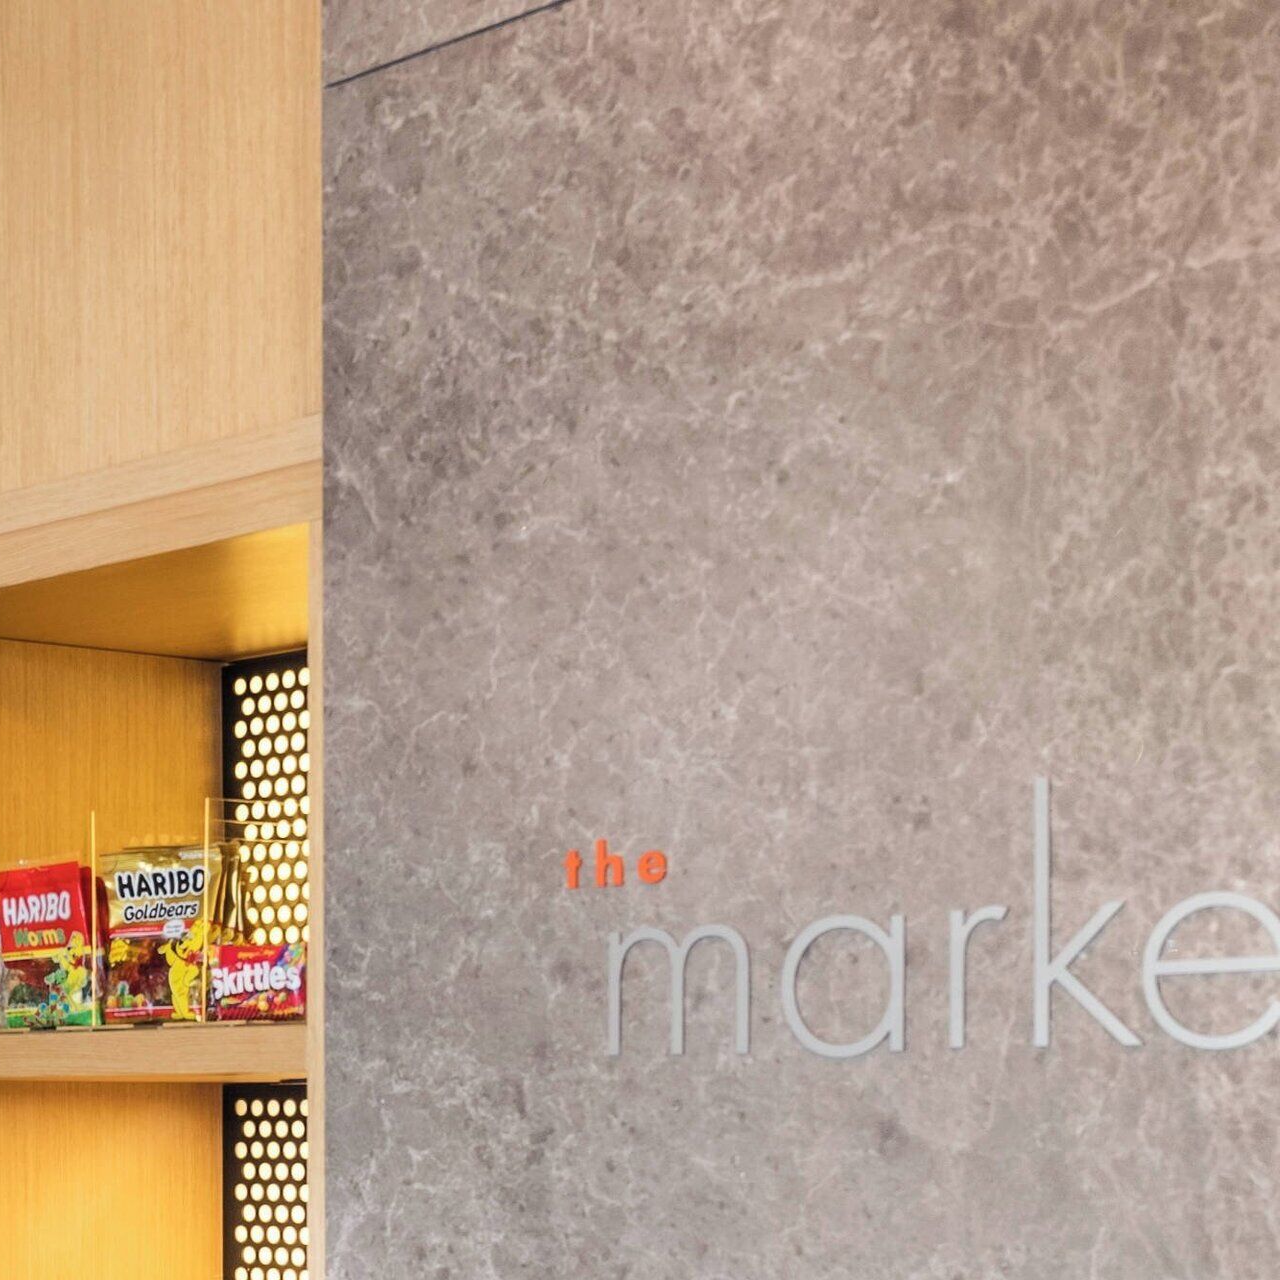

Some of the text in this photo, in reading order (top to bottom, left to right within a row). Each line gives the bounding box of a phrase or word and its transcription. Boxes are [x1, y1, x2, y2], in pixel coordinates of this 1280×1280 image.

[563, 838, 668, 889] the
[116, 867, 207, 899] HARIBO
[2, 890, 71, 927] HARIBO
[124, 902, 198, 922] Goldbears
[13, 927, 66, 947] Worms
[211, 961, 302, 999] Skittles
